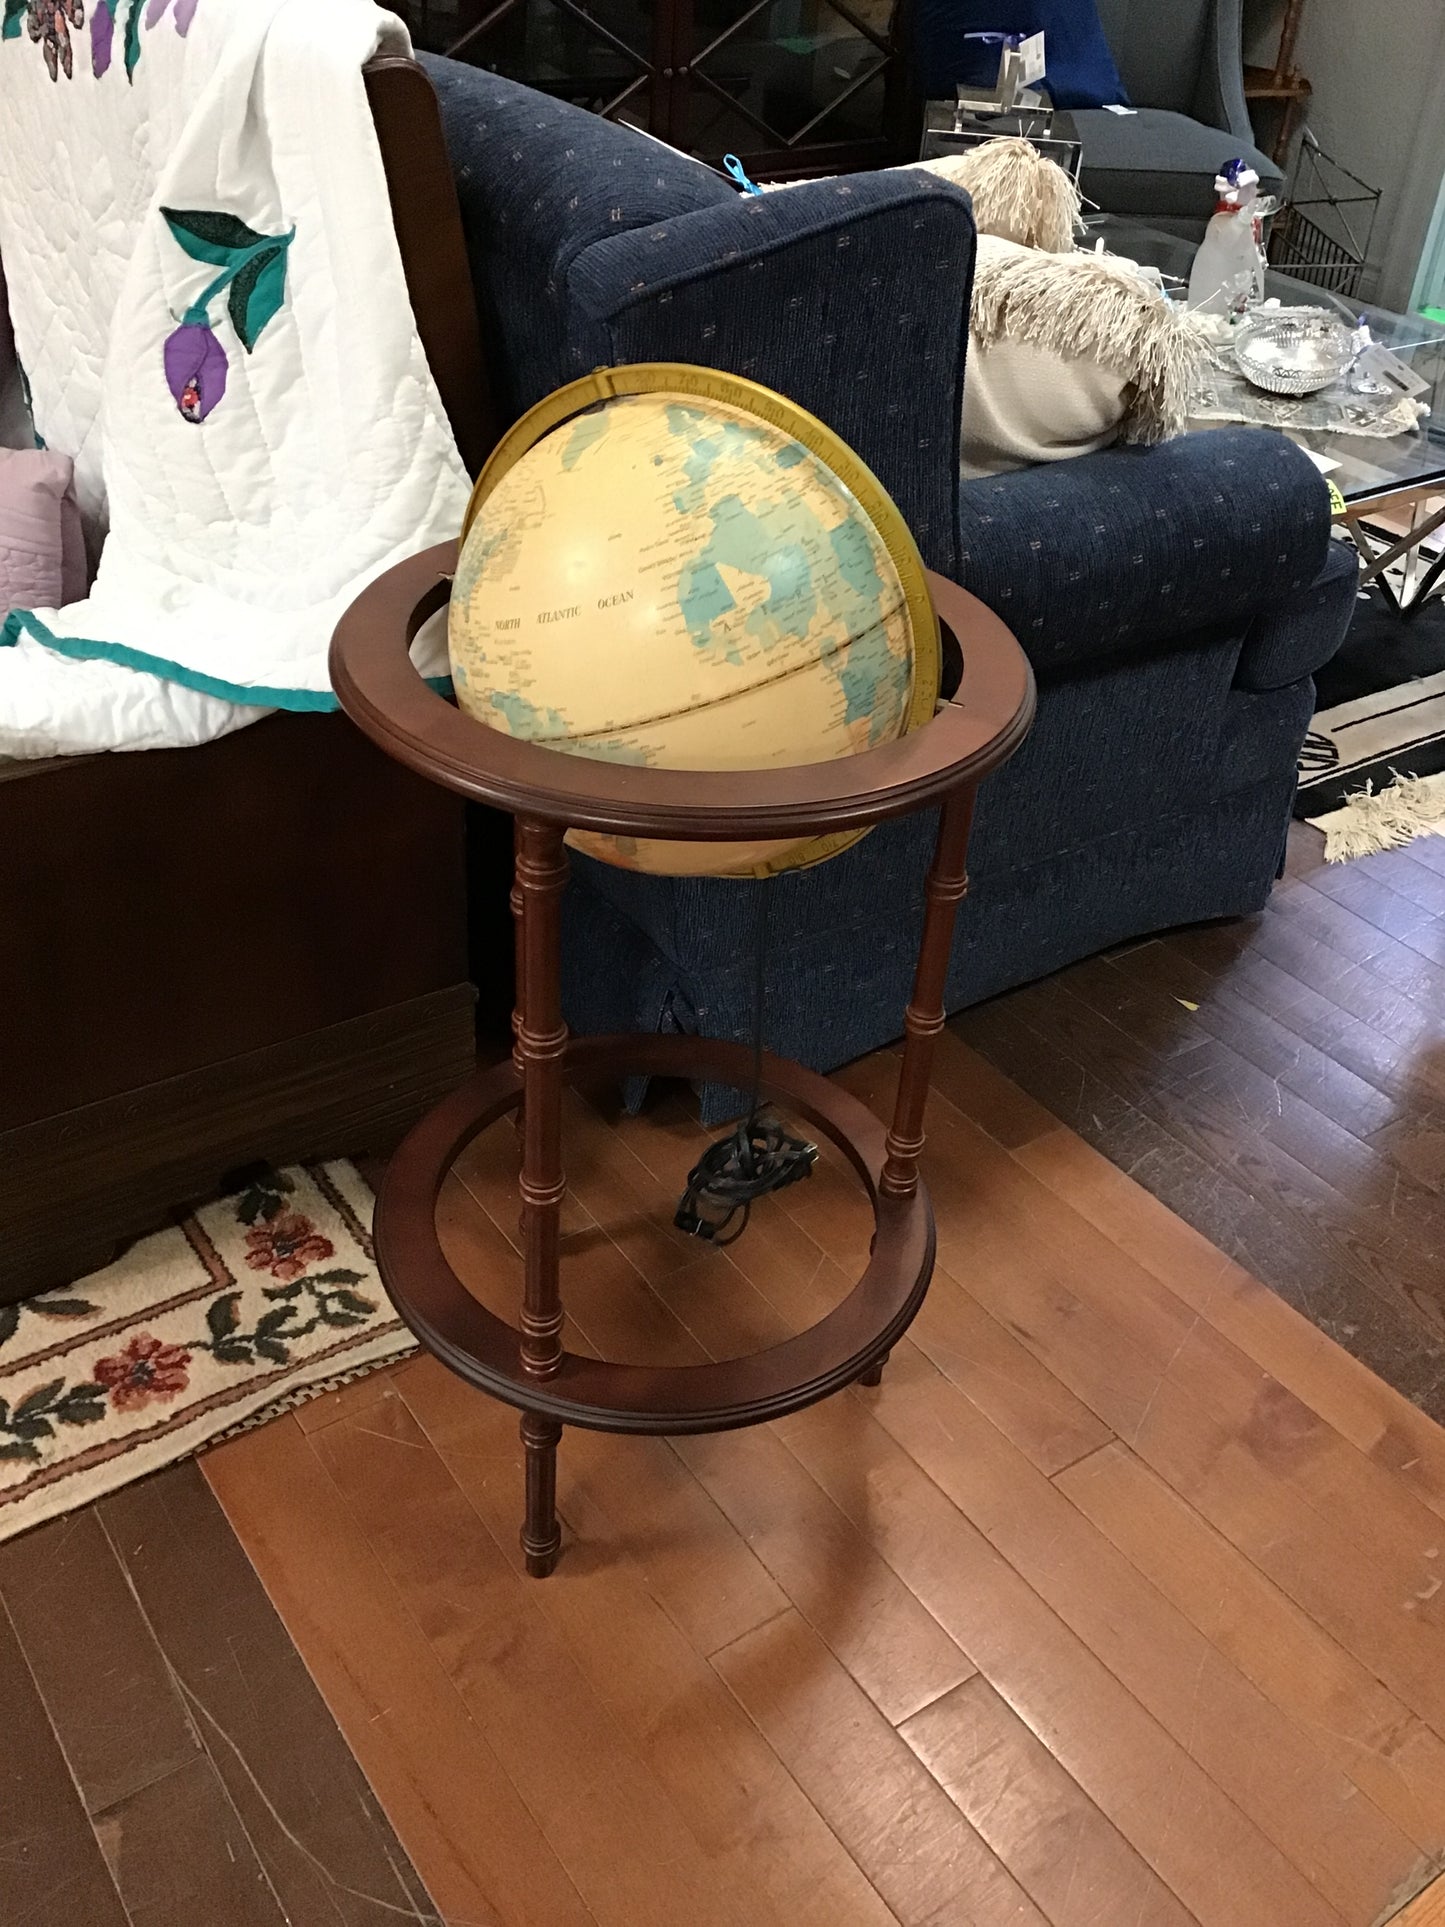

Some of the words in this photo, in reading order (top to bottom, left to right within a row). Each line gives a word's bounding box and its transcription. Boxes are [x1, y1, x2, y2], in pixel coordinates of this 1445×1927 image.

[495, 618, 520, 630] NORTH
[537, 605, 581, 623] ATLANTIC
[598, 589, 634, 609] OCEAN
